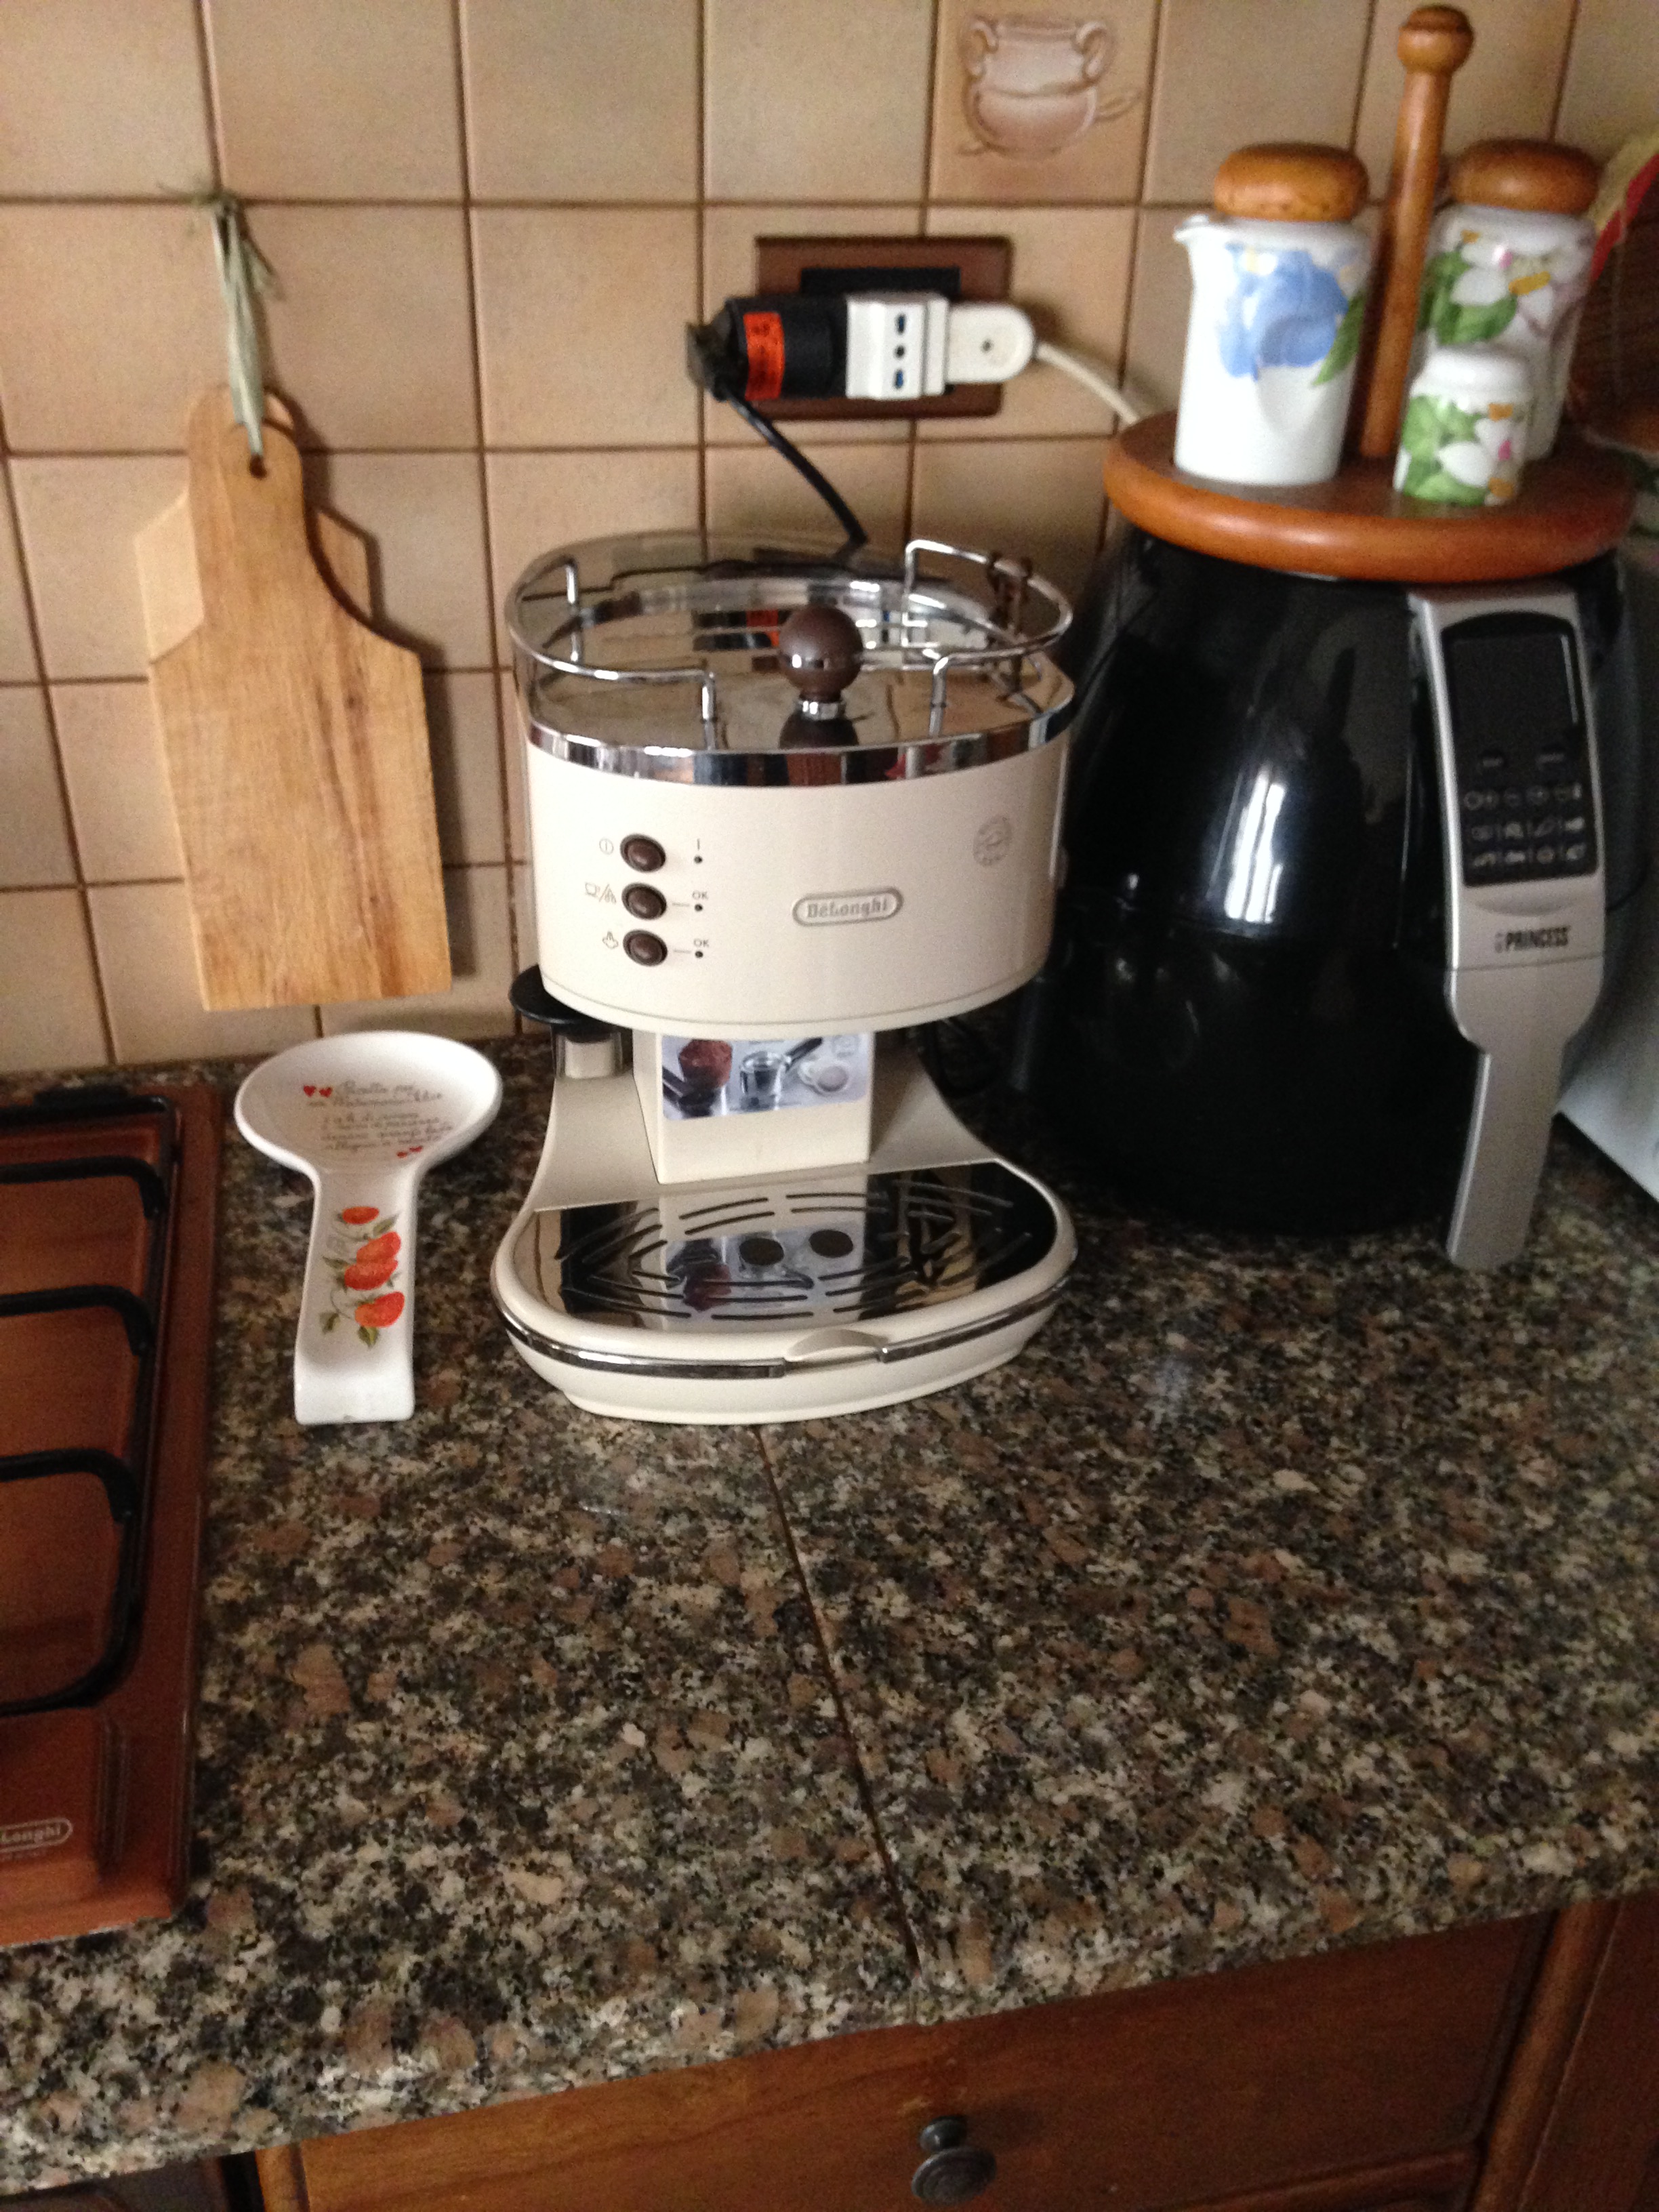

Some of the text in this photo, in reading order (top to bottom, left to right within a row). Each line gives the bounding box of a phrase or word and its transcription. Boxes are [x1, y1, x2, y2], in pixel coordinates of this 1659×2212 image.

[692, 890, 709, 901] OK
[693, 938, 710, 948] OK
[1, 1822, 62, 1844] Longhi
